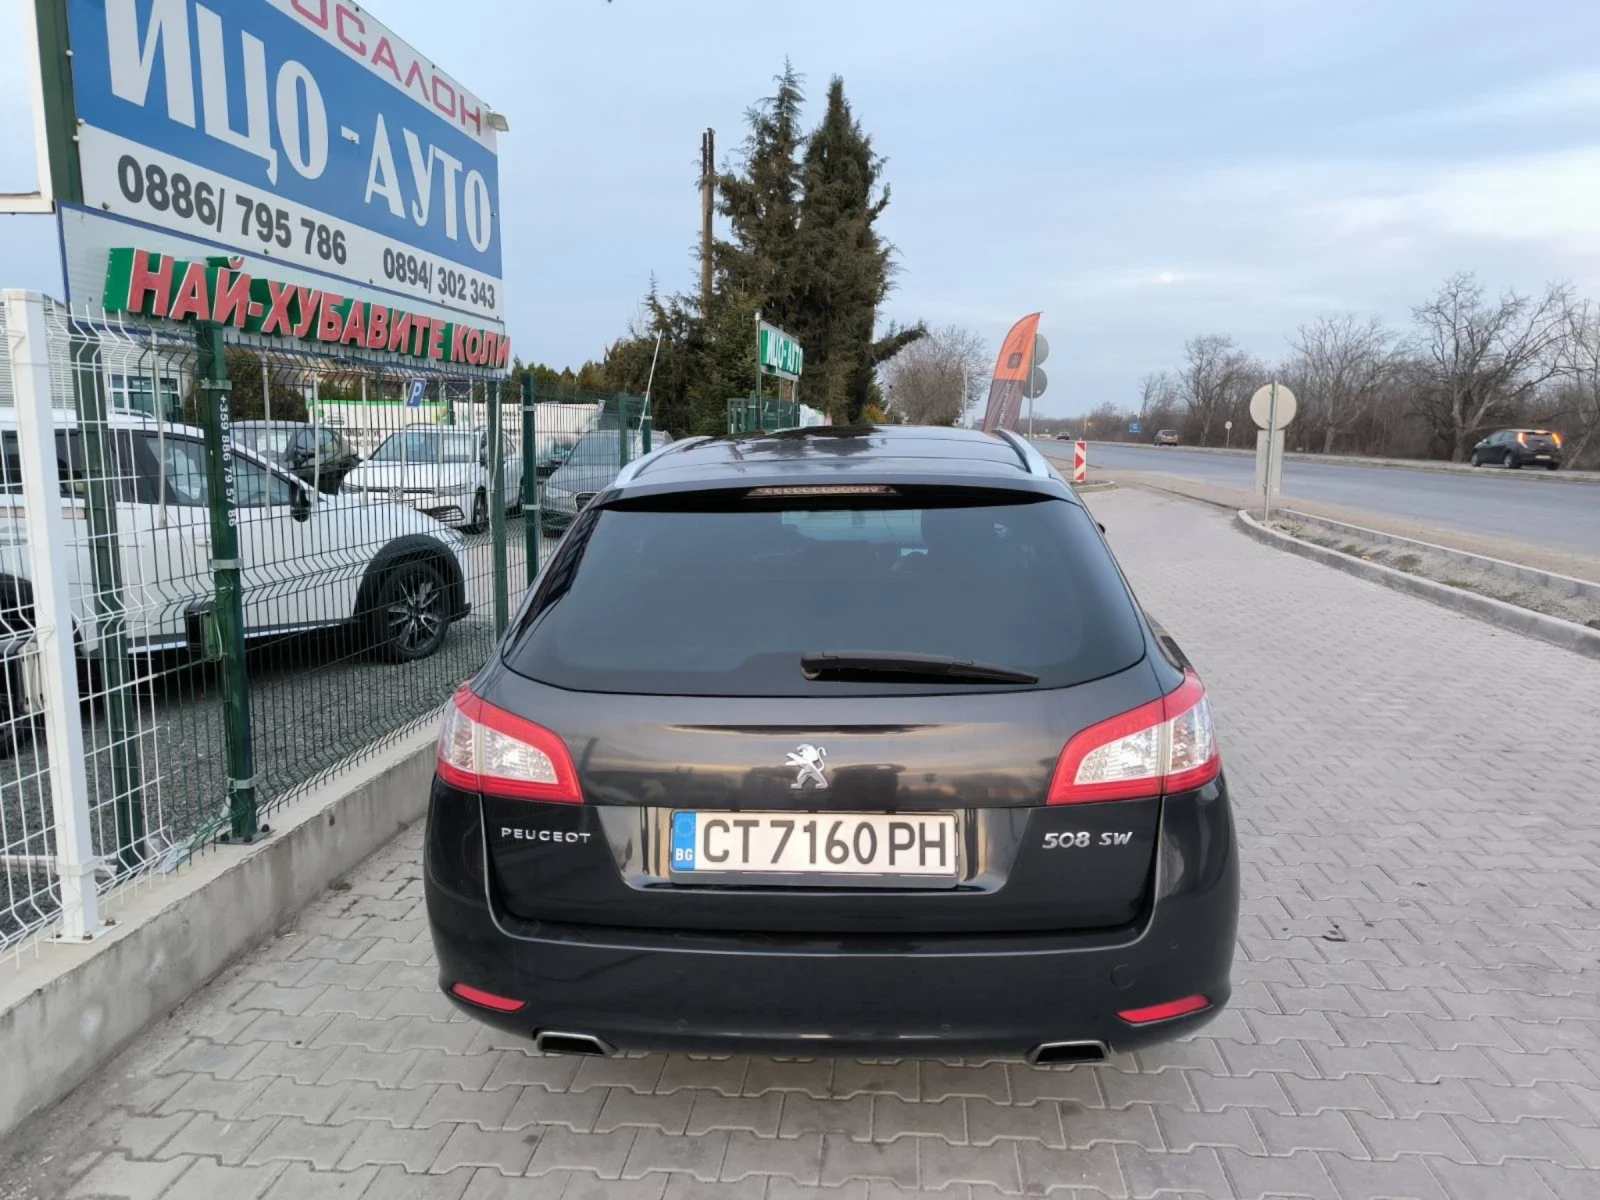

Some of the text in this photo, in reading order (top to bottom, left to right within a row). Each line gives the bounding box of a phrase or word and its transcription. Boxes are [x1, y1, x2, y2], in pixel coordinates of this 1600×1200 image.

[118, 154, 496, 310] 0886/ 795 786 0894/ 302 343
[451, 323, 511, 369] КОЛИ
[410, 381, 423, 405] P
[219, 395, 230, 431] +359
[221, 434, 232, 462] 886
[224, 465, 234, 484] 79
[226, 488, 236, 504] 57
[500, 826, 592, 844] PEUGEOT
[1041, 831, 1134, 850] 508 SW
[675, 847, 694, 862] BG
